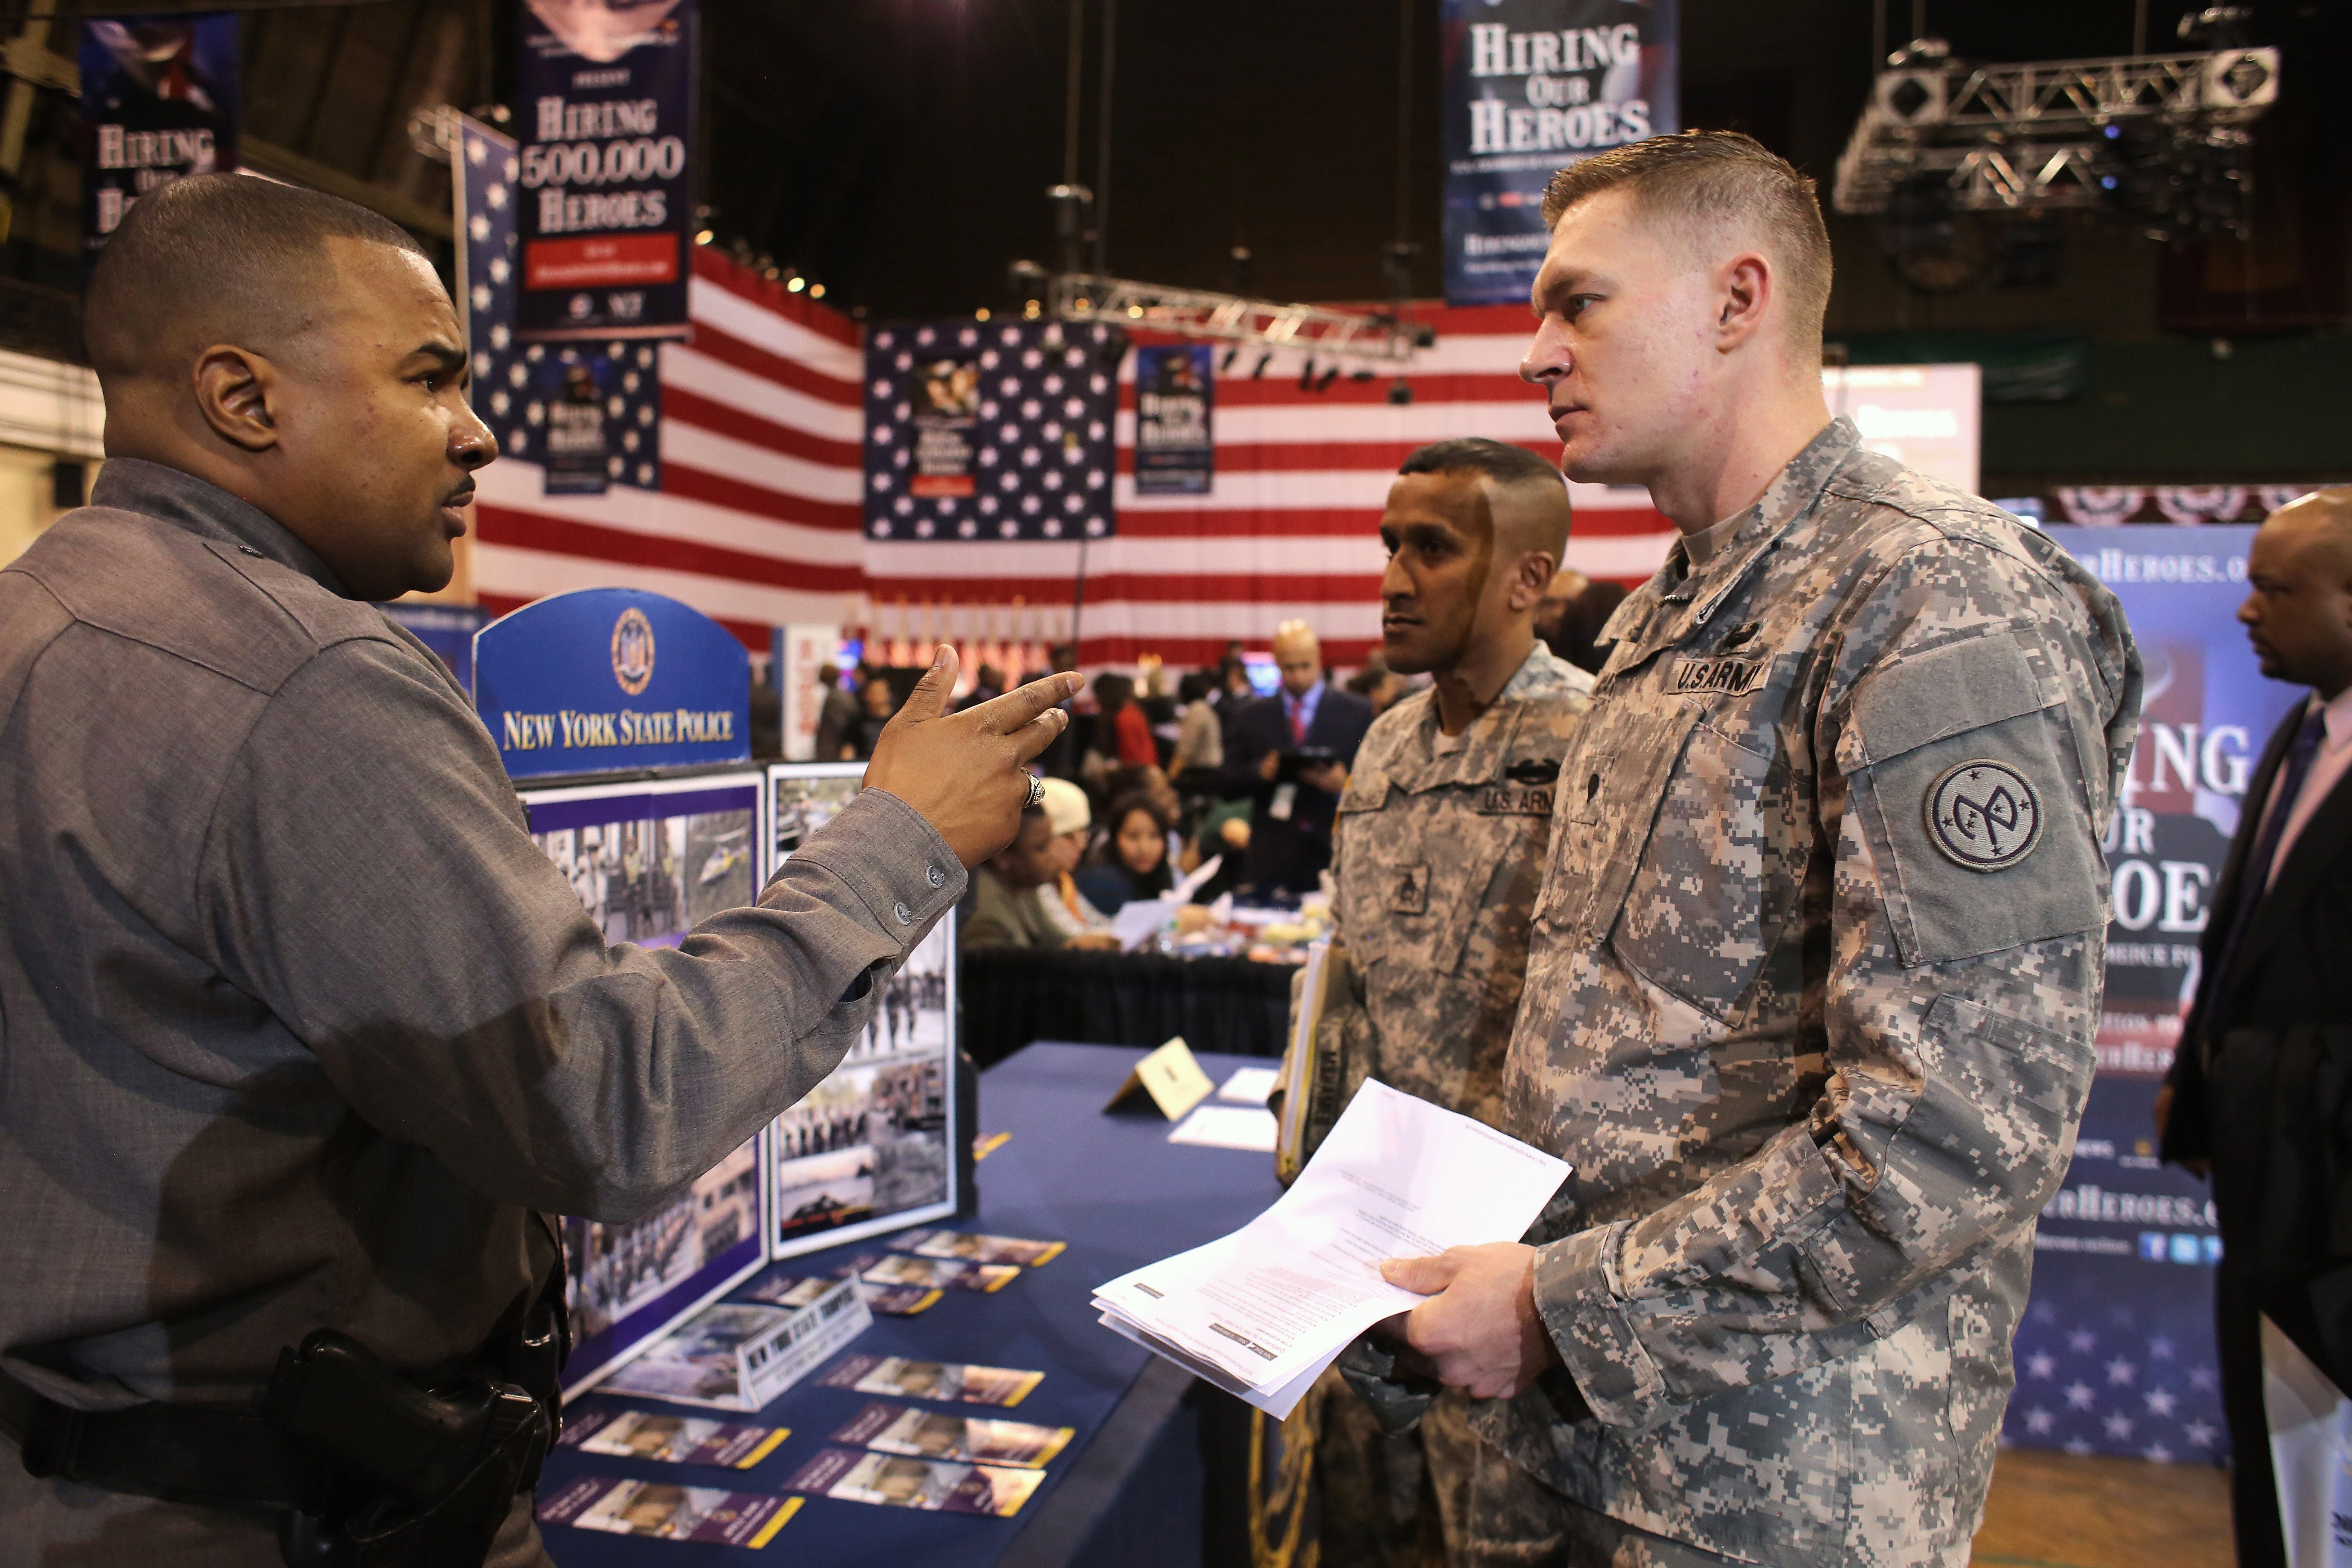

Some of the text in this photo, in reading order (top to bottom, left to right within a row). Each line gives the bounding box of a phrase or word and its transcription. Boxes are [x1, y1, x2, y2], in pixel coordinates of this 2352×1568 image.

[1470, 23, 1640, 77] HIRING
[1526, 74, 1590, 108] OUR
[537, 96, 658, 142] HIRING
[1470, 100, 1651, 154] HEROES
[98, 124, 215, 169] HIRING
[521, 136, 686, 189] 500,000
[539, 187, 667, 234] HEROES
[503, 708, 733, 751] NEW YORK STATE POLICE
